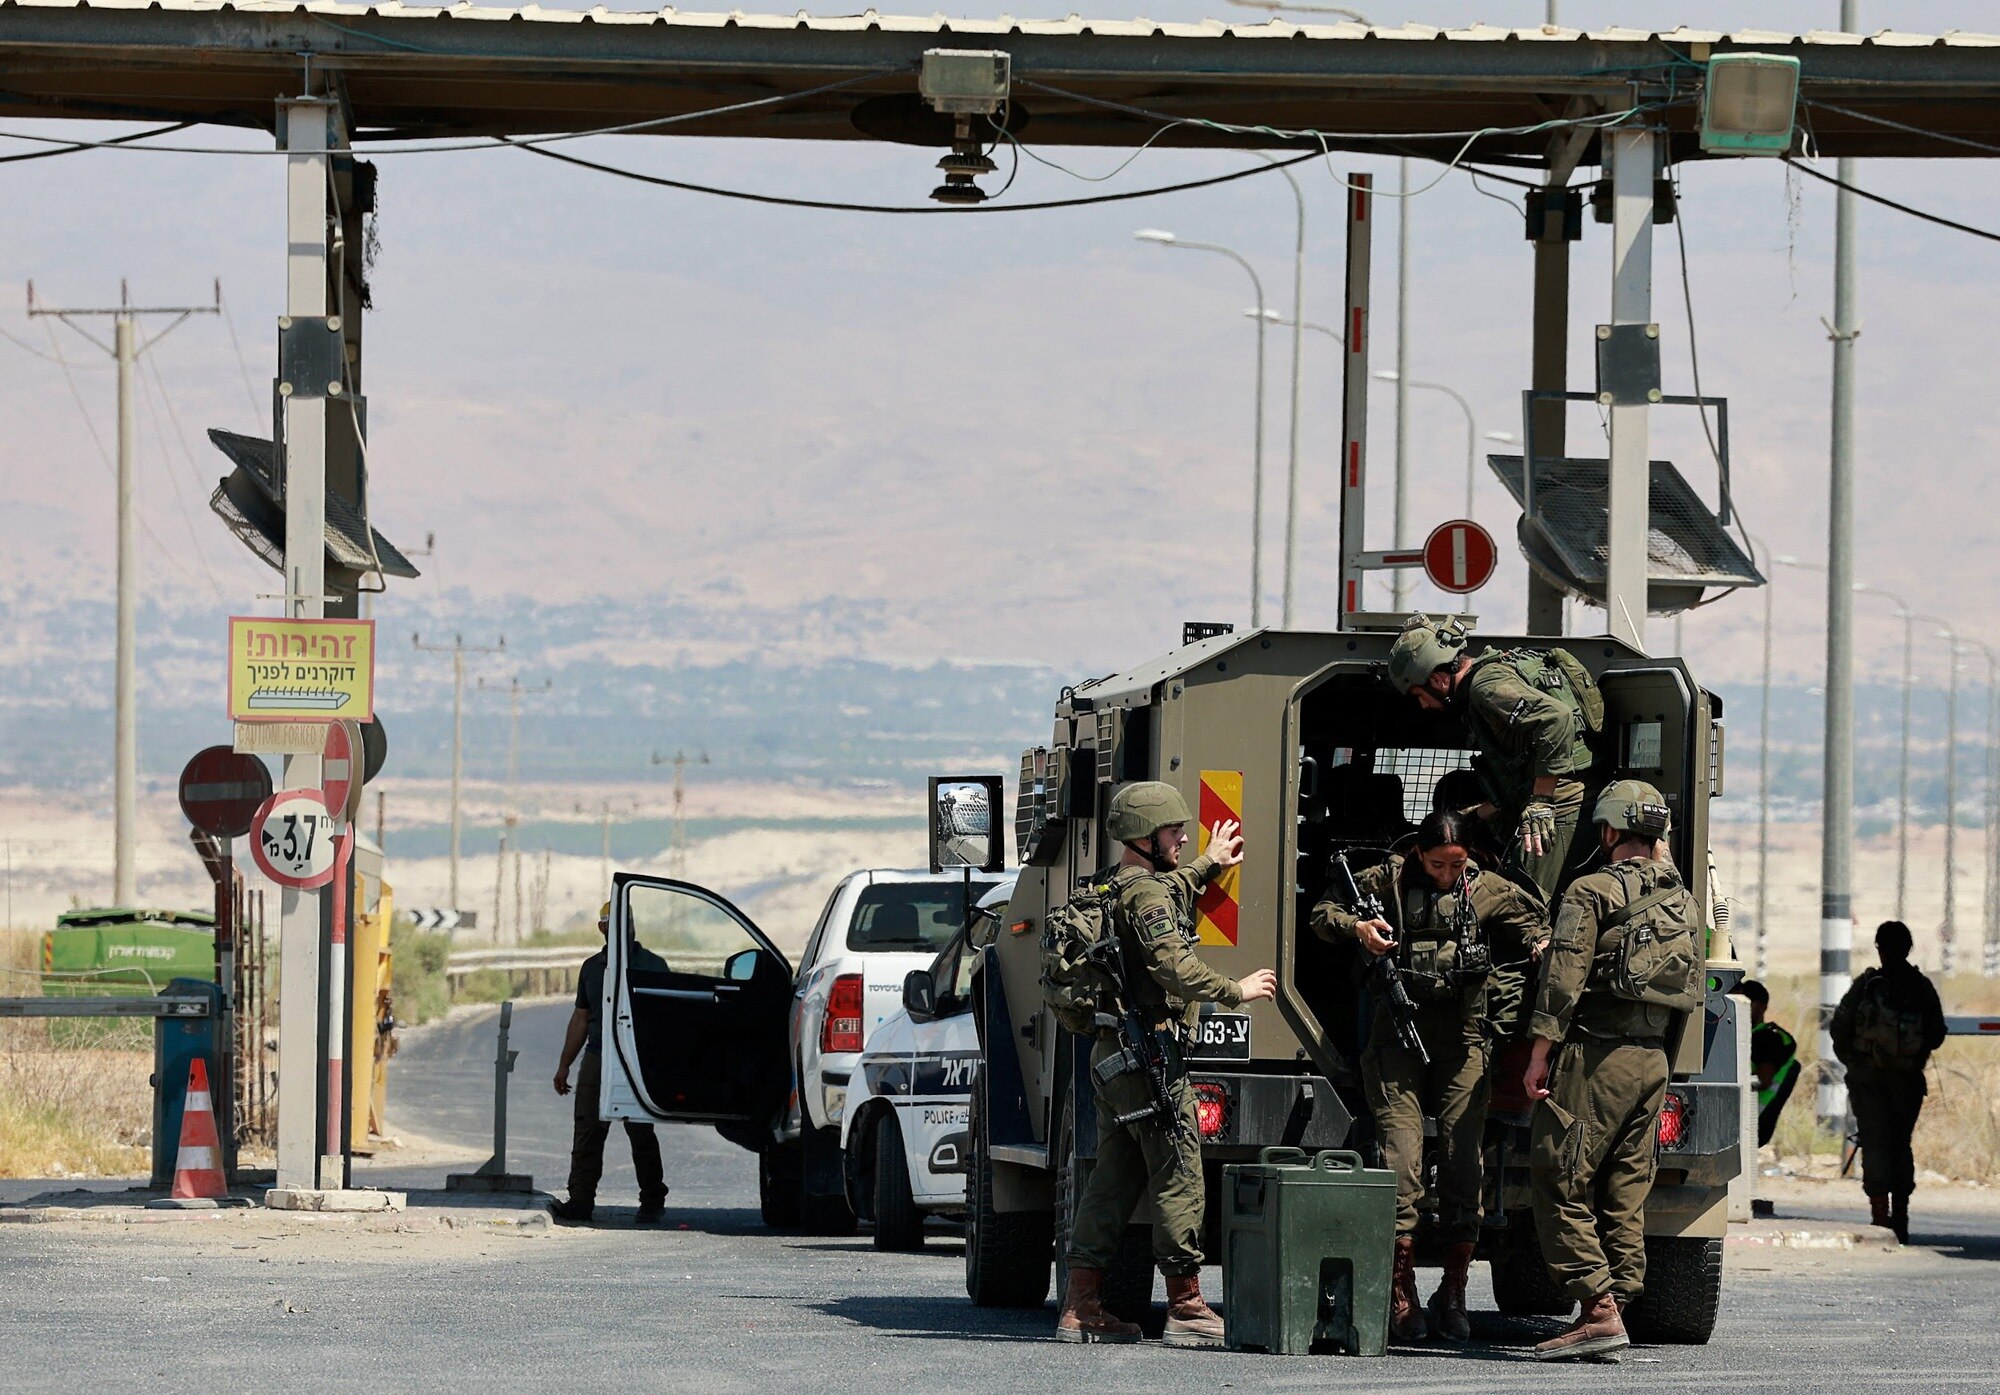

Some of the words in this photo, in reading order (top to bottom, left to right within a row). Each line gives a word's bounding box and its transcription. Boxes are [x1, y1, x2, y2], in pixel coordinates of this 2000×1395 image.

[247, 630, 357, 658] זהירות!
[247, 662, 290, 684] לפניך
[296, 667, 355, 686] דוקרנים
[924, 1110, 954, 1124] POLICE
